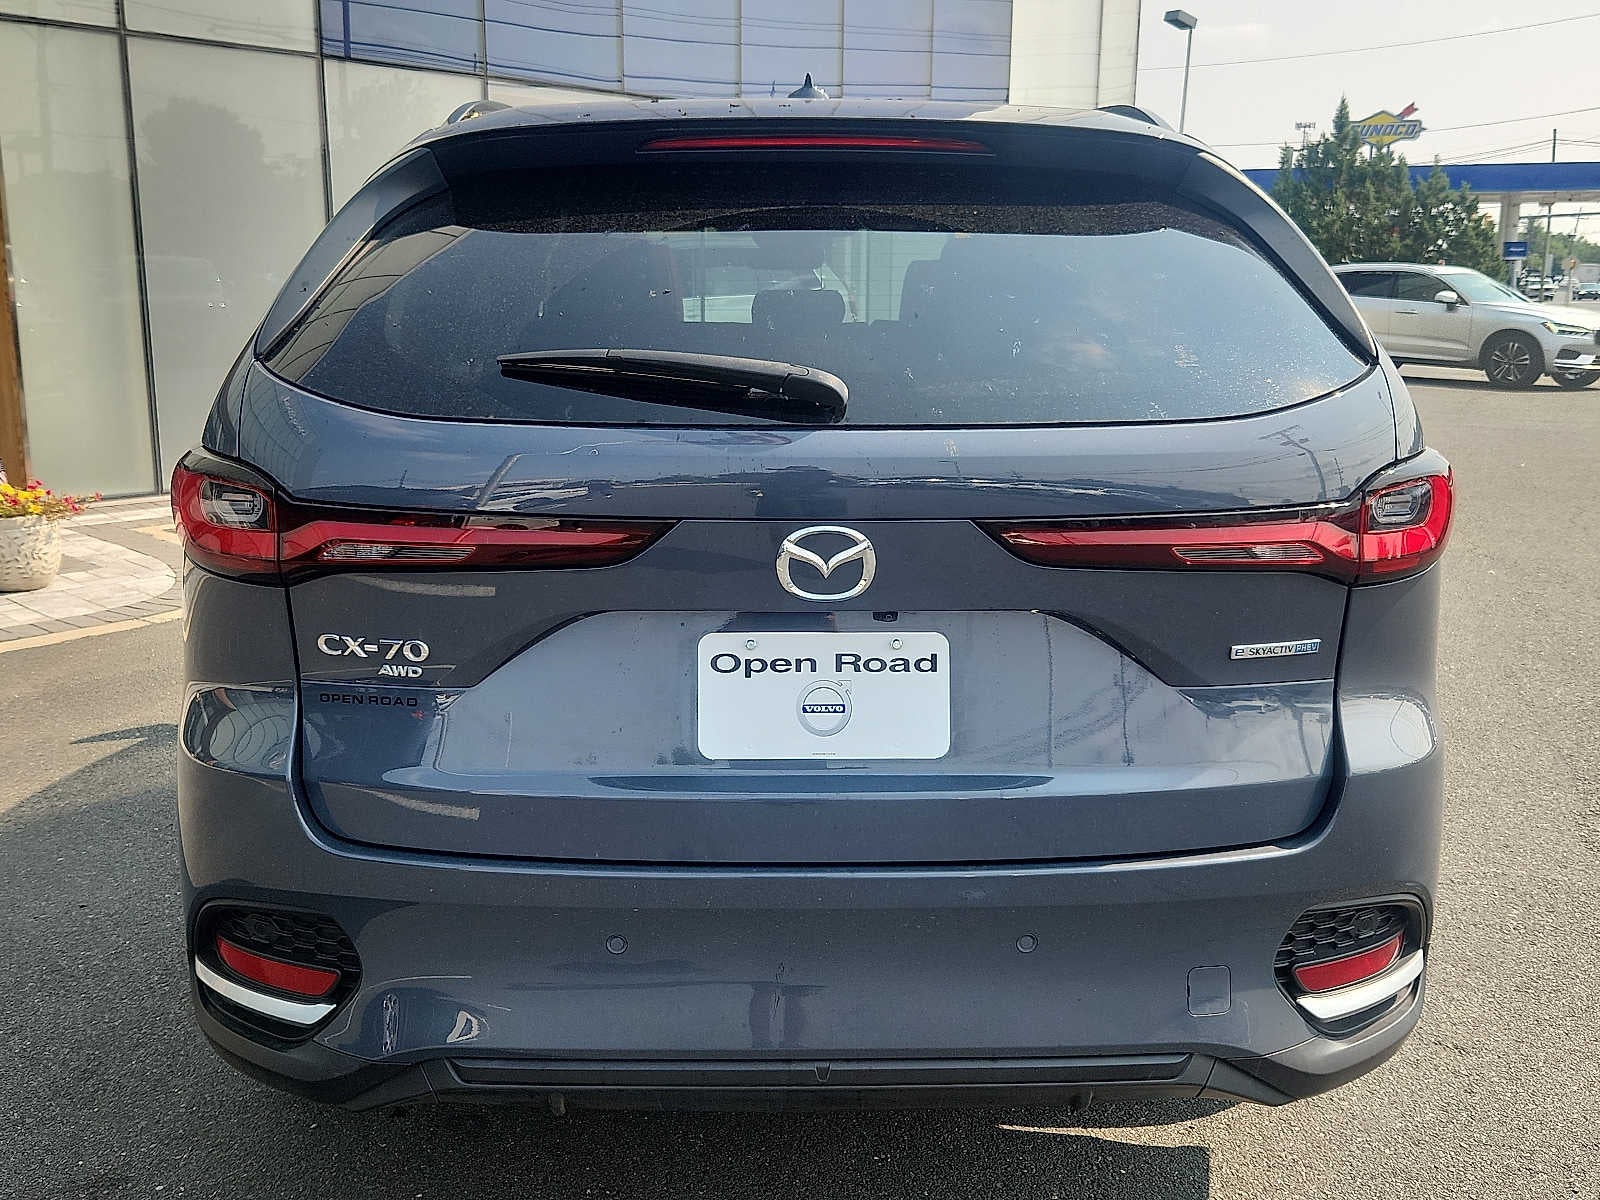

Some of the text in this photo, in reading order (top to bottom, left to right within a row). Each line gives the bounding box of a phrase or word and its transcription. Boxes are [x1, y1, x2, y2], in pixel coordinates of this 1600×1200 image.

[317, 633, 430, 662] CX-70
[1248, 645, 1294, 656] SKYACTIV
[1295, 643, 1317, 652] PHEV
[377, 664, 423, 678] AWD
[710, 653, 938, 679] Open Road
[319, 692, 418, 707] OPEN ROAD
[803, 705, 845, 713] VOLVO
